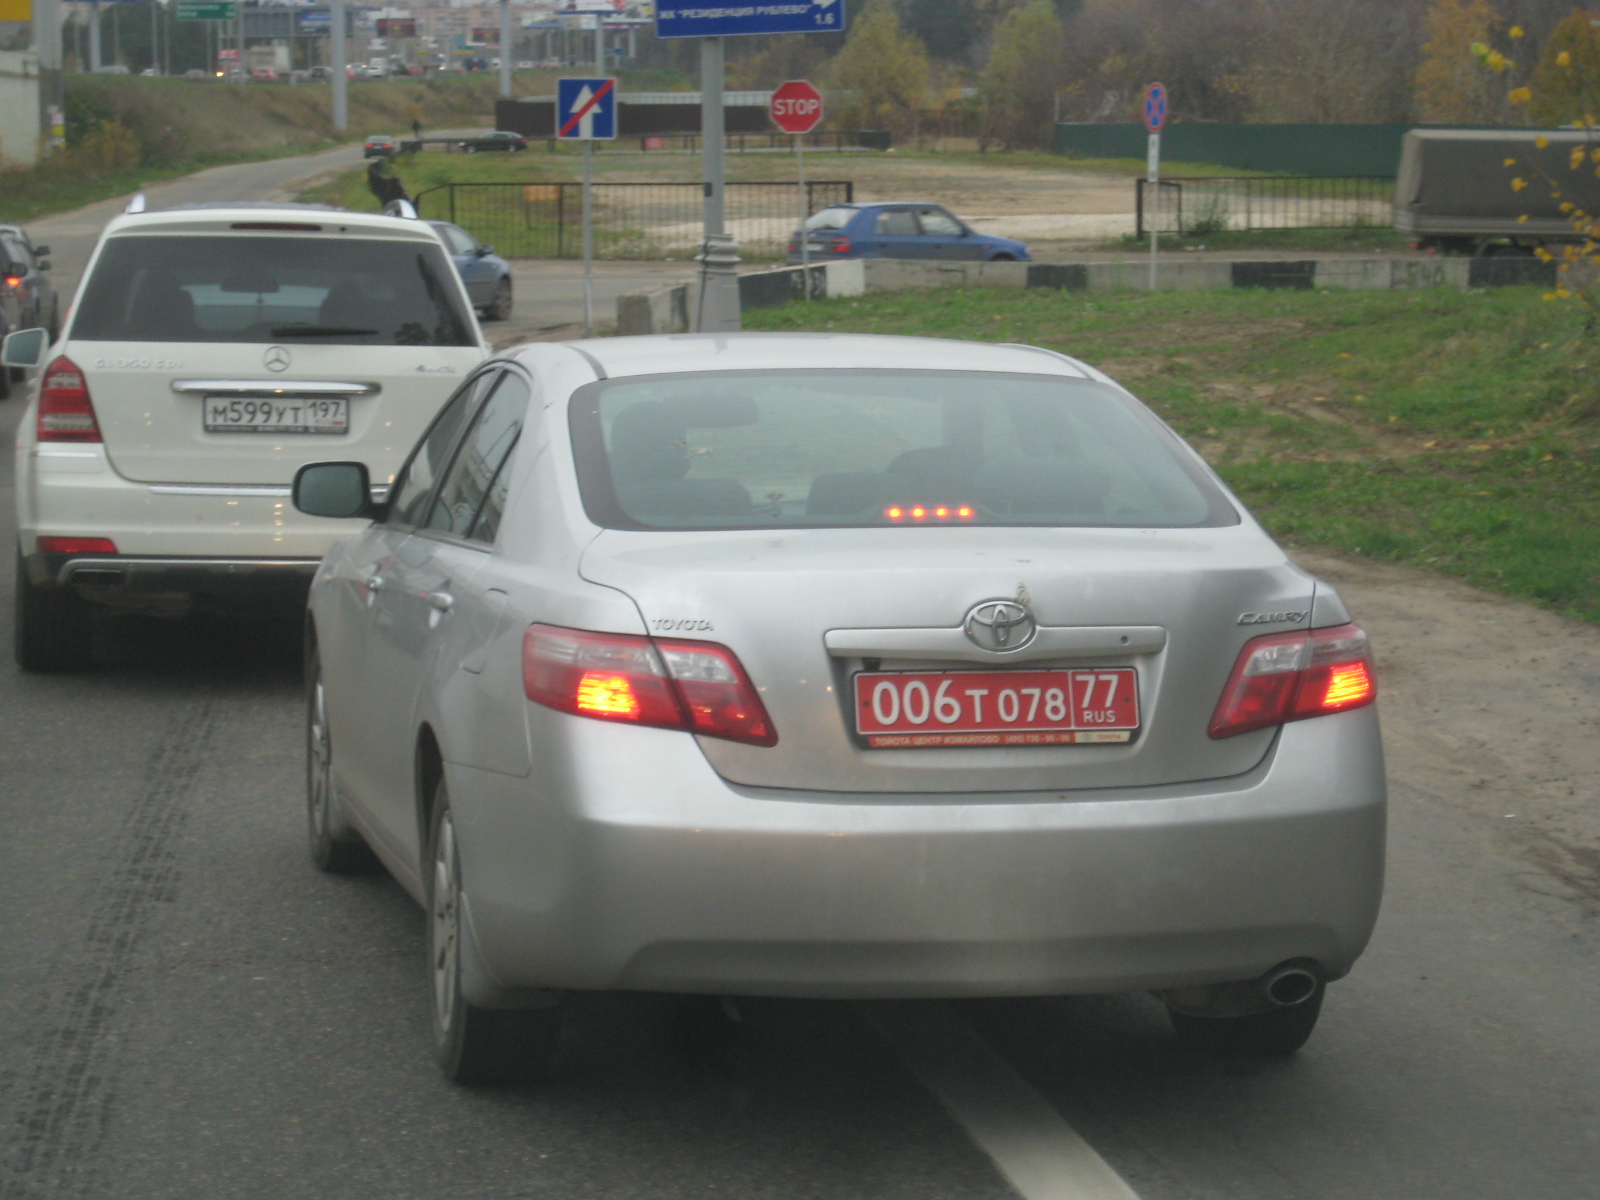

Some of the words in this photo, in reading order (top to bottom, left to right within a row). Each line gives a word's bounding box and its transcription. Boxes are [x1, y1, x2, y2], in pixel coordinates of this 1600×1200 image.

[814, 12, 835, 25] 1.6
[773, 98, 819, 116] STOP
[308, 401, 341, 418] 197
[652, 619, 714, 631] TOYOTA
[1236, 610, 1310, 625] CAMRY
[1075, 673, 1120, 709] 77
[1083, 710, 1117, 723] RUS
